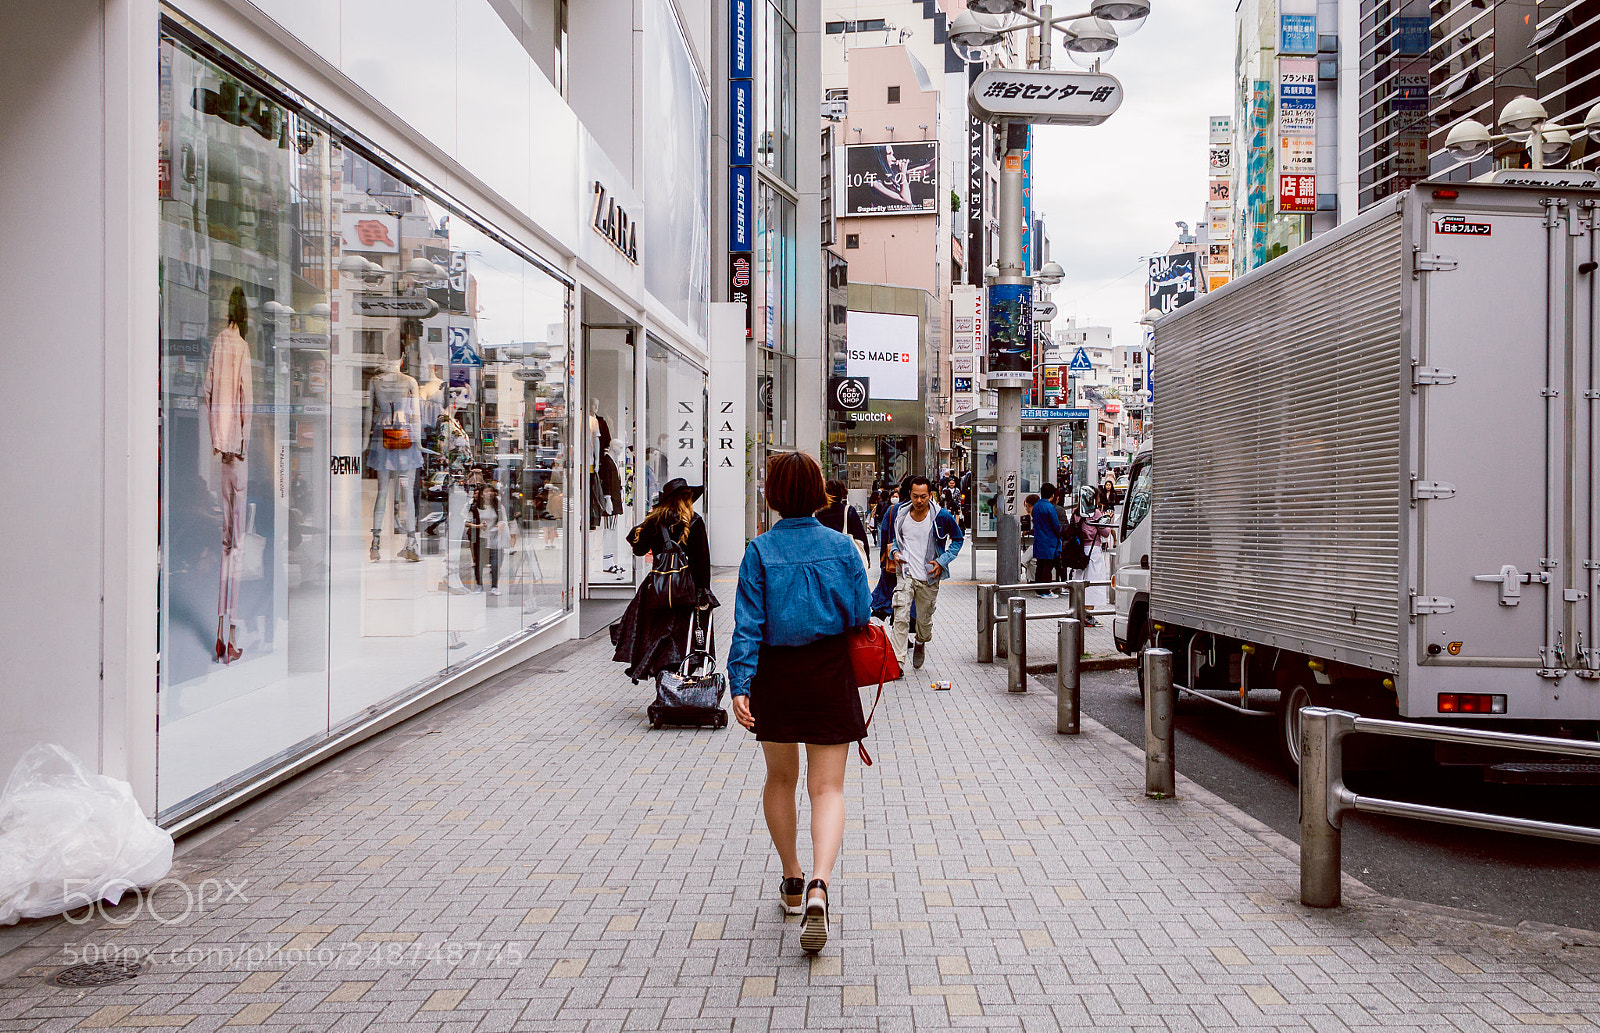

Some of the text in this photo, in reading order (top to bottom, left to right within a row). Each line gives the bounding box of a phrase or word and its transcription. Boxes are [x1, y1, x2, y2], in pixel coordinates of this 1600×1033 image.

[737, 0, 745, 71] SKECHERS
[983, 82, 1115, 102] 渋谷センター街
[737, 87, 745, 158] SKECHERS
[847, 171, 877, 187] 10年
[1281, 176, 1314, 196] 店舗
[737, 174, 745, 244] SKECHERS
[594, 181, 638, 264] ZARA
[1445, 224, 1490, 233] 日本フルハーフ
[1018, 293, 1027, 336] 九十九島
[847, 350, 899, 362] ISS MADE
[851, 411, 886, 421] swatch
[1064, 410, 1089, 418] Hyakkaten
[719, 402, 735, 467] ZARA
